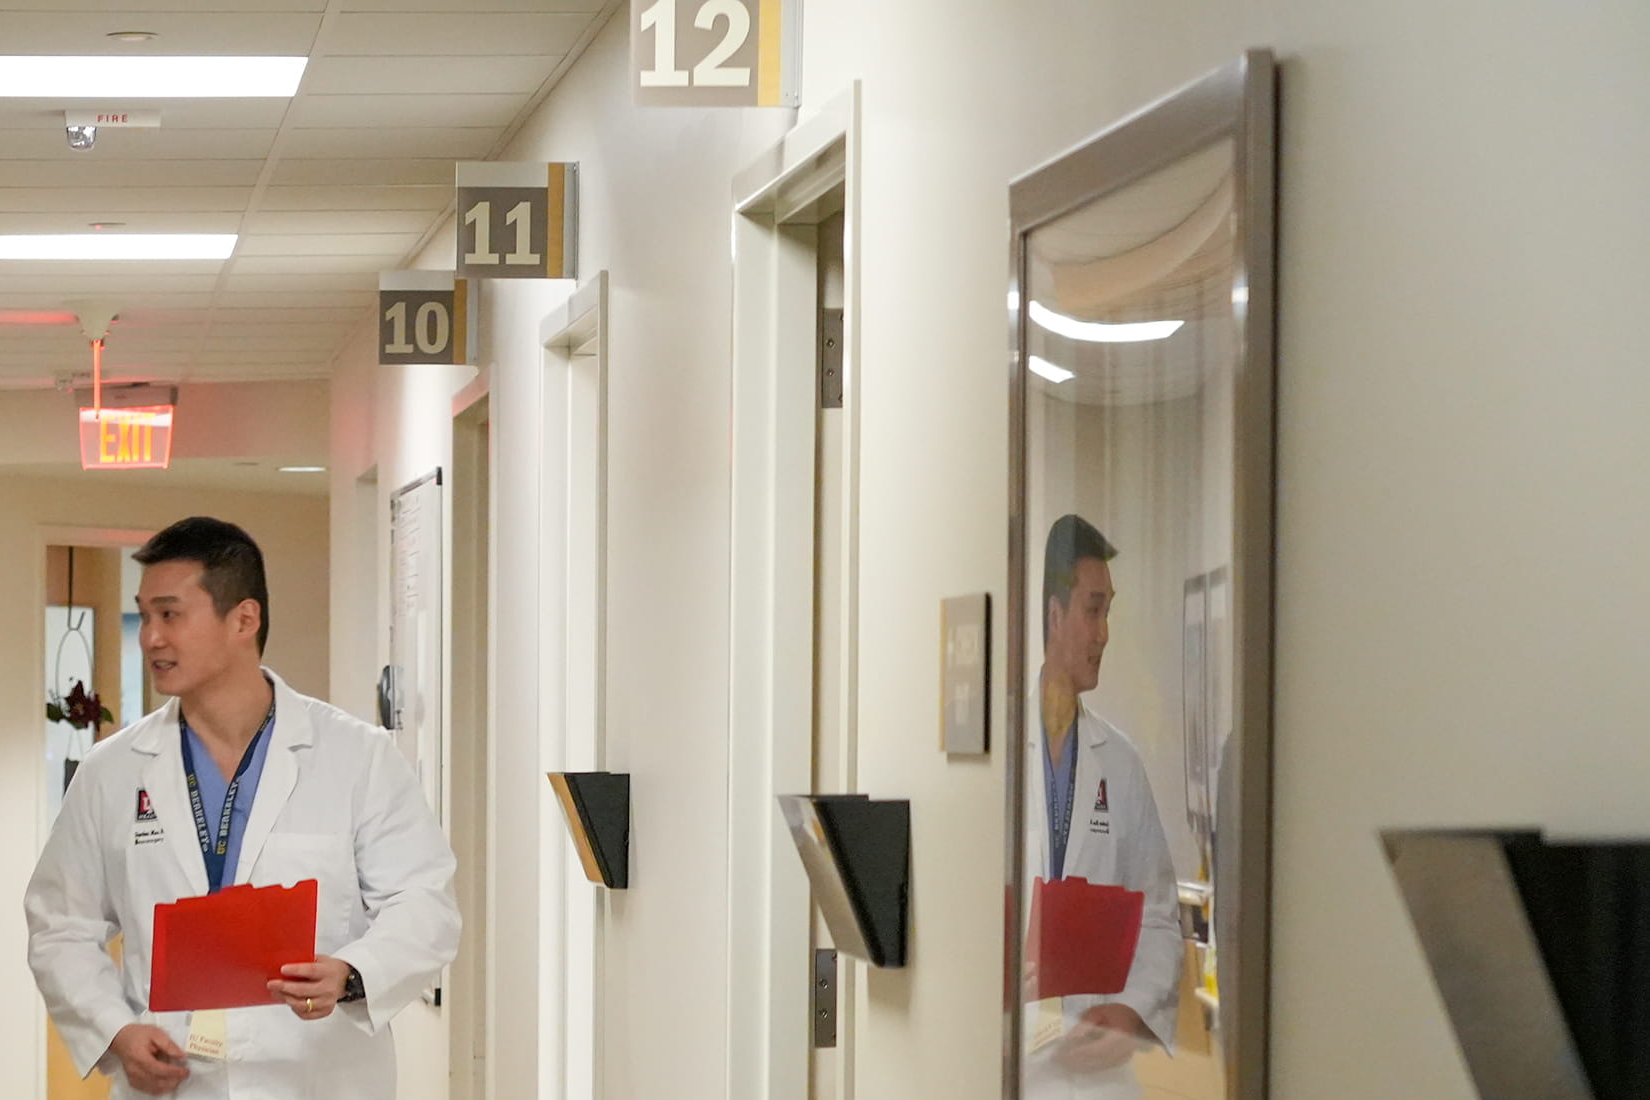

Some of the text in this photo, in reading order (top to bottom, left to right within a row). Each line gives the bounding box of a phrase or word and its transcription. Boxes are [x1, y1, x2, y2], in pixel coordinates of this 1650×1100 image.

[639, 0, 752, 88] 12
[96, 113, 127, 123] FIRE
[463, 200, 541, 266] 11
[383, 300, 451, 355] 10
[99, 412, 157, 463] EXIT
[191, 790, 210, 844] BERKELEY
[217, 782, 238, 854] UC BERKELEY
